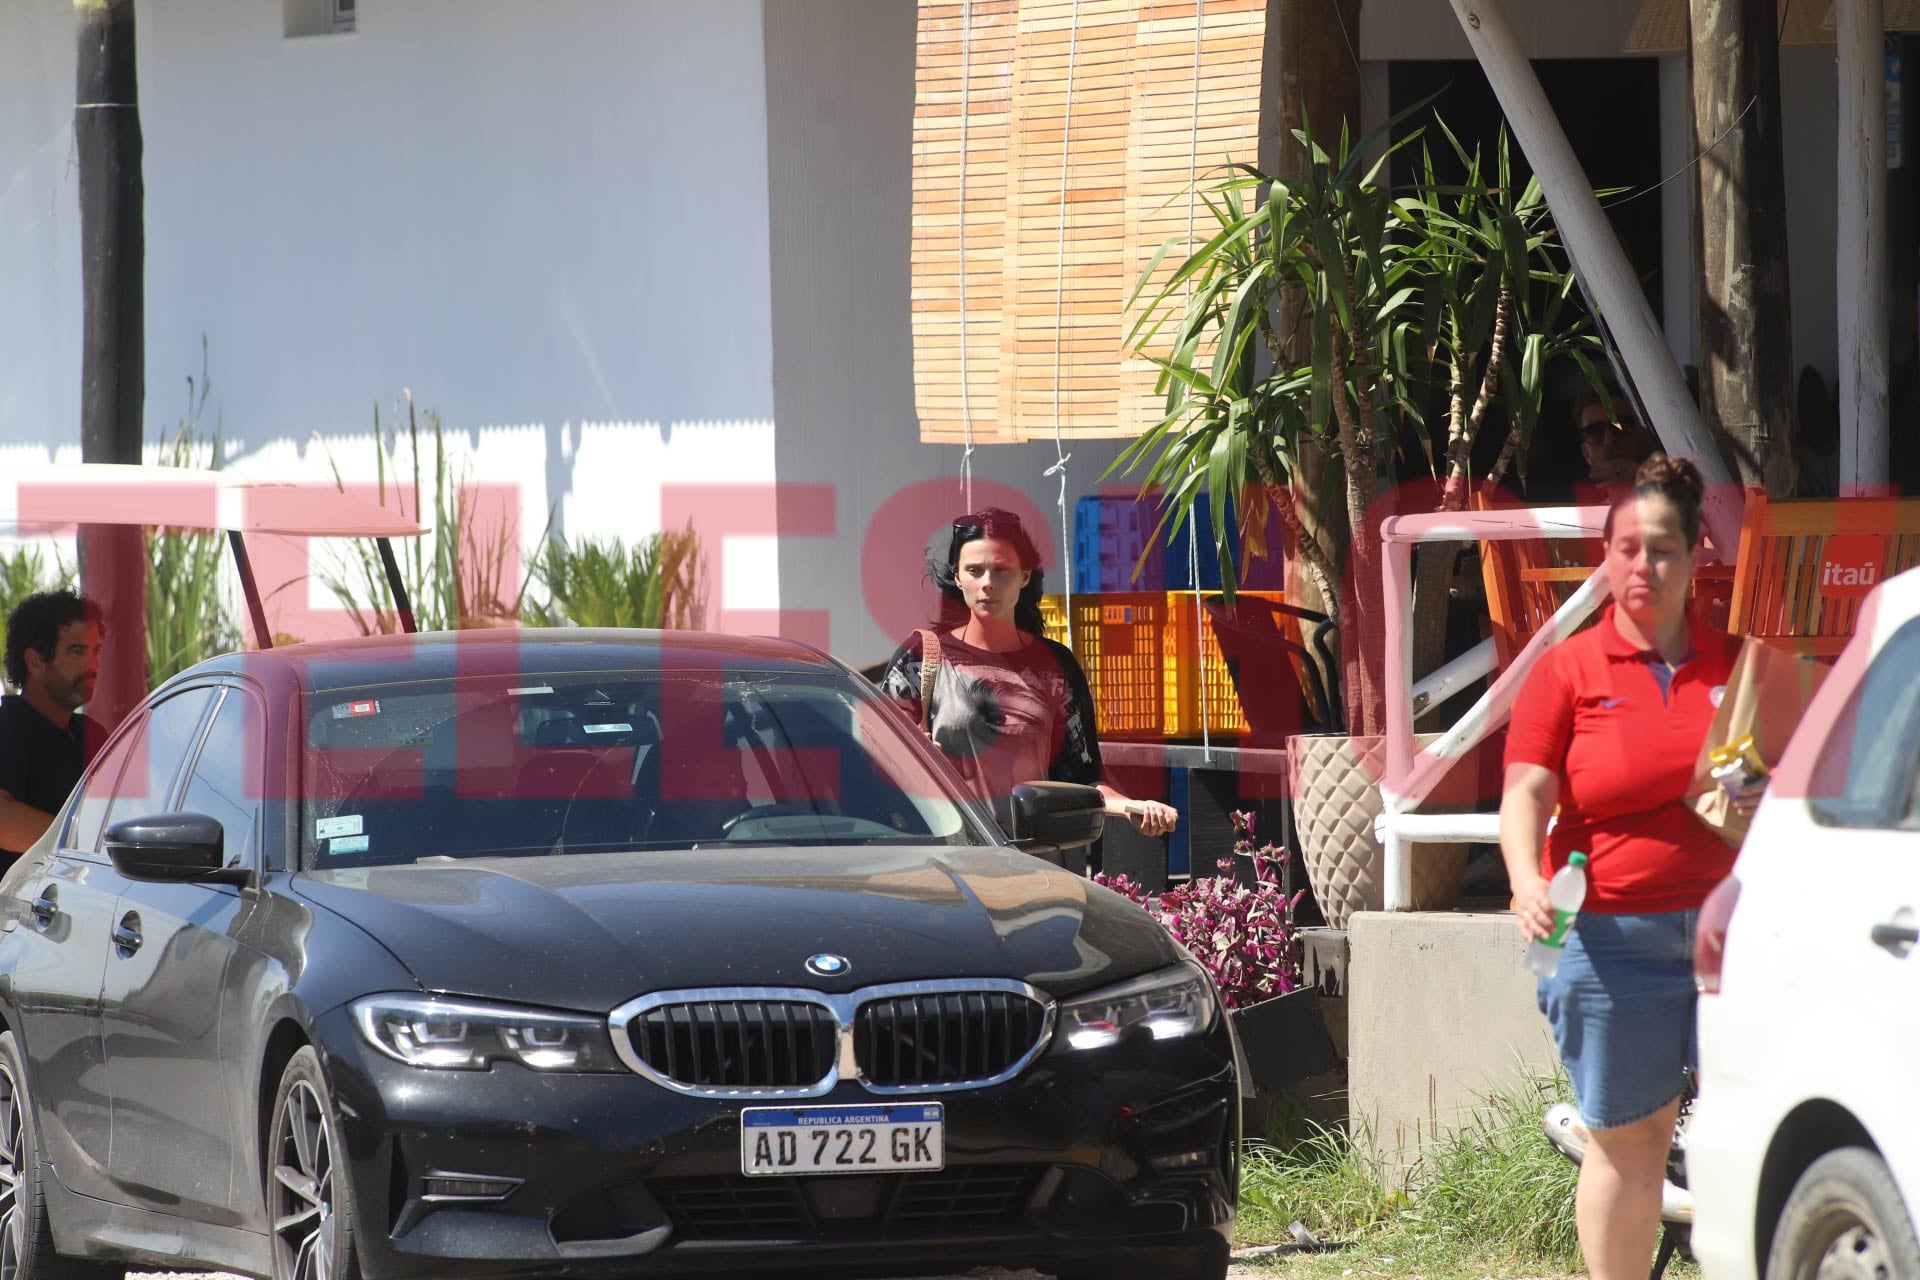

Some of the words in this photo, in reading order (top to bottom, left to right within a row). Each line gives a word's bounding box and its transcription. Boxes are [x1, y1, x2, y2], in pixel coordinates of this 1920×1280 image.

[1823, 561, 1876, 586] itaú
[798, 1116, 843, 1126] REPUBLICA
[844, 1114, 890, 1125] ARGENTINA
[754, 1131, 798, 1168] AD
[811, 1129, 877, 1166] 722
[890, 1126, 934, 1163] GK
